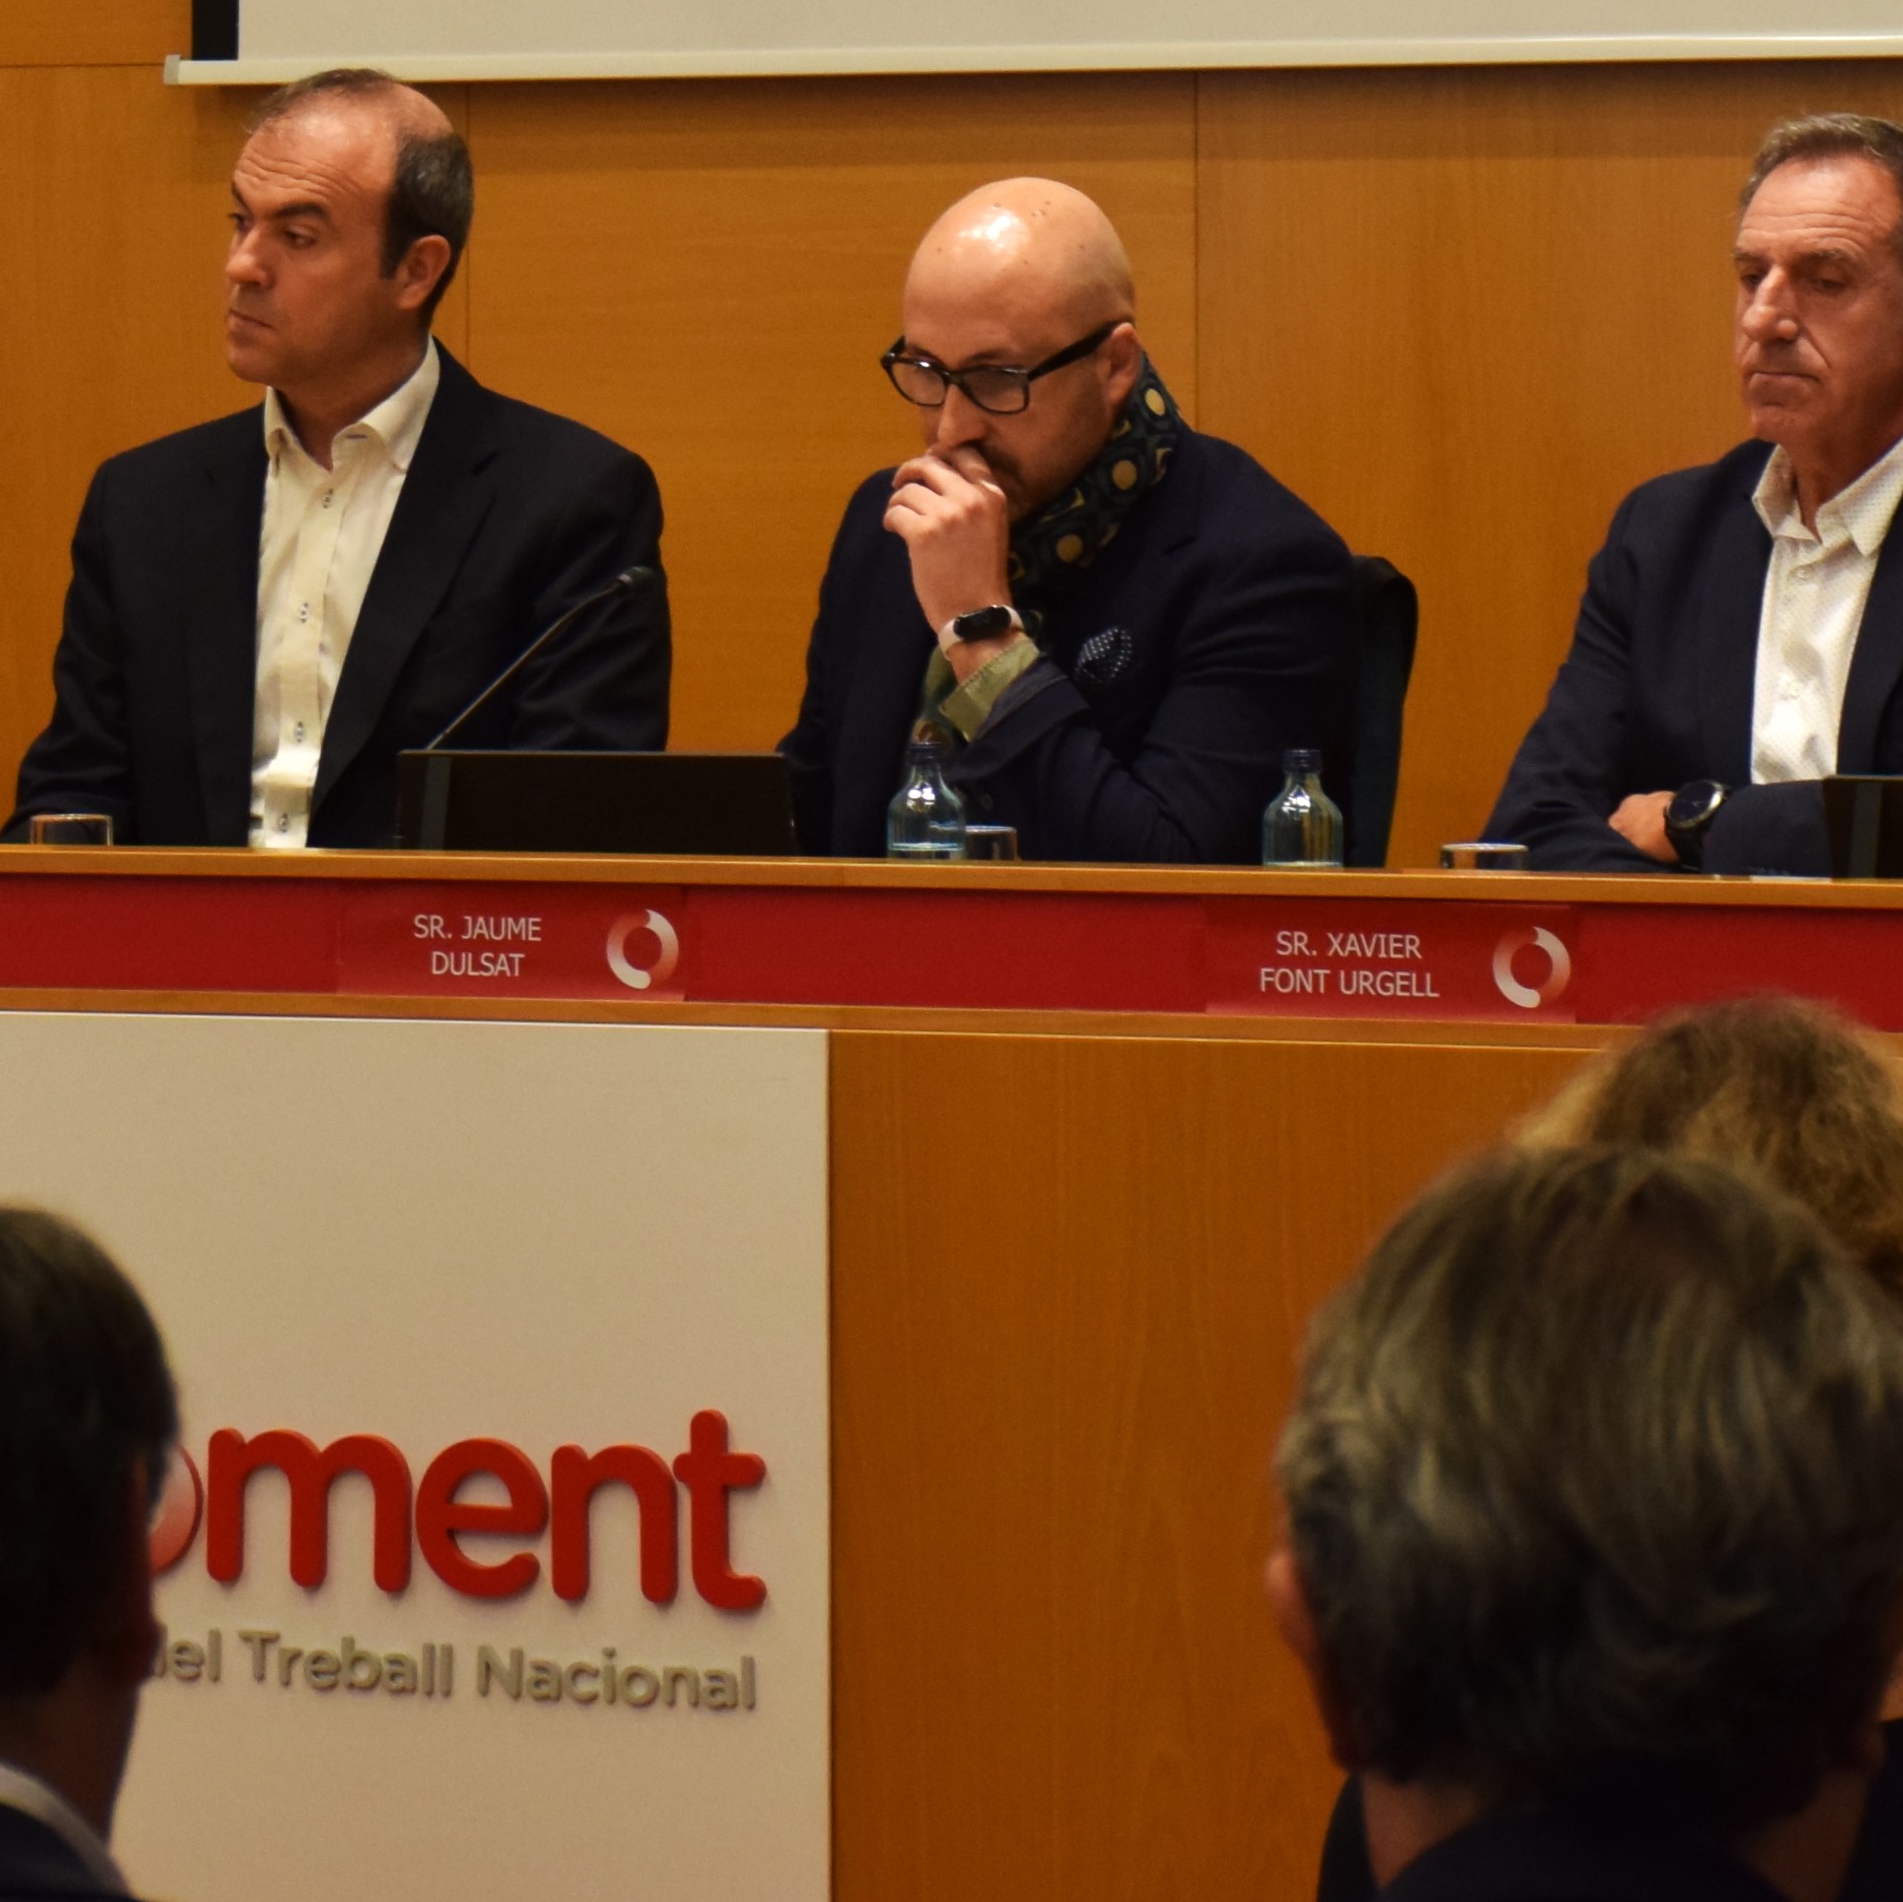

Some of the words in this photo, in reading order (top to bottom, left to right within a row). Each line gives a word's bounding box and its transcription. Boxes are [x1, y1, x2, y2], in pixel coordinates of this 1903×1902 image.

[413, 913, 453, 939] SR.
[461, 915, 542, 942] JAUME
[1276, 930, 1318, 956] SR.
[1327, 932, 1423, 959] XAVIER
[431, 950, 526, 977] DULSAT
[1260, 967, 1331, 994] FONT
[1339, 969, 1440, 998] URGELL
[239, 1629, 454, 1698] Treball
[476, 1645, 757, 1710] Nacional
